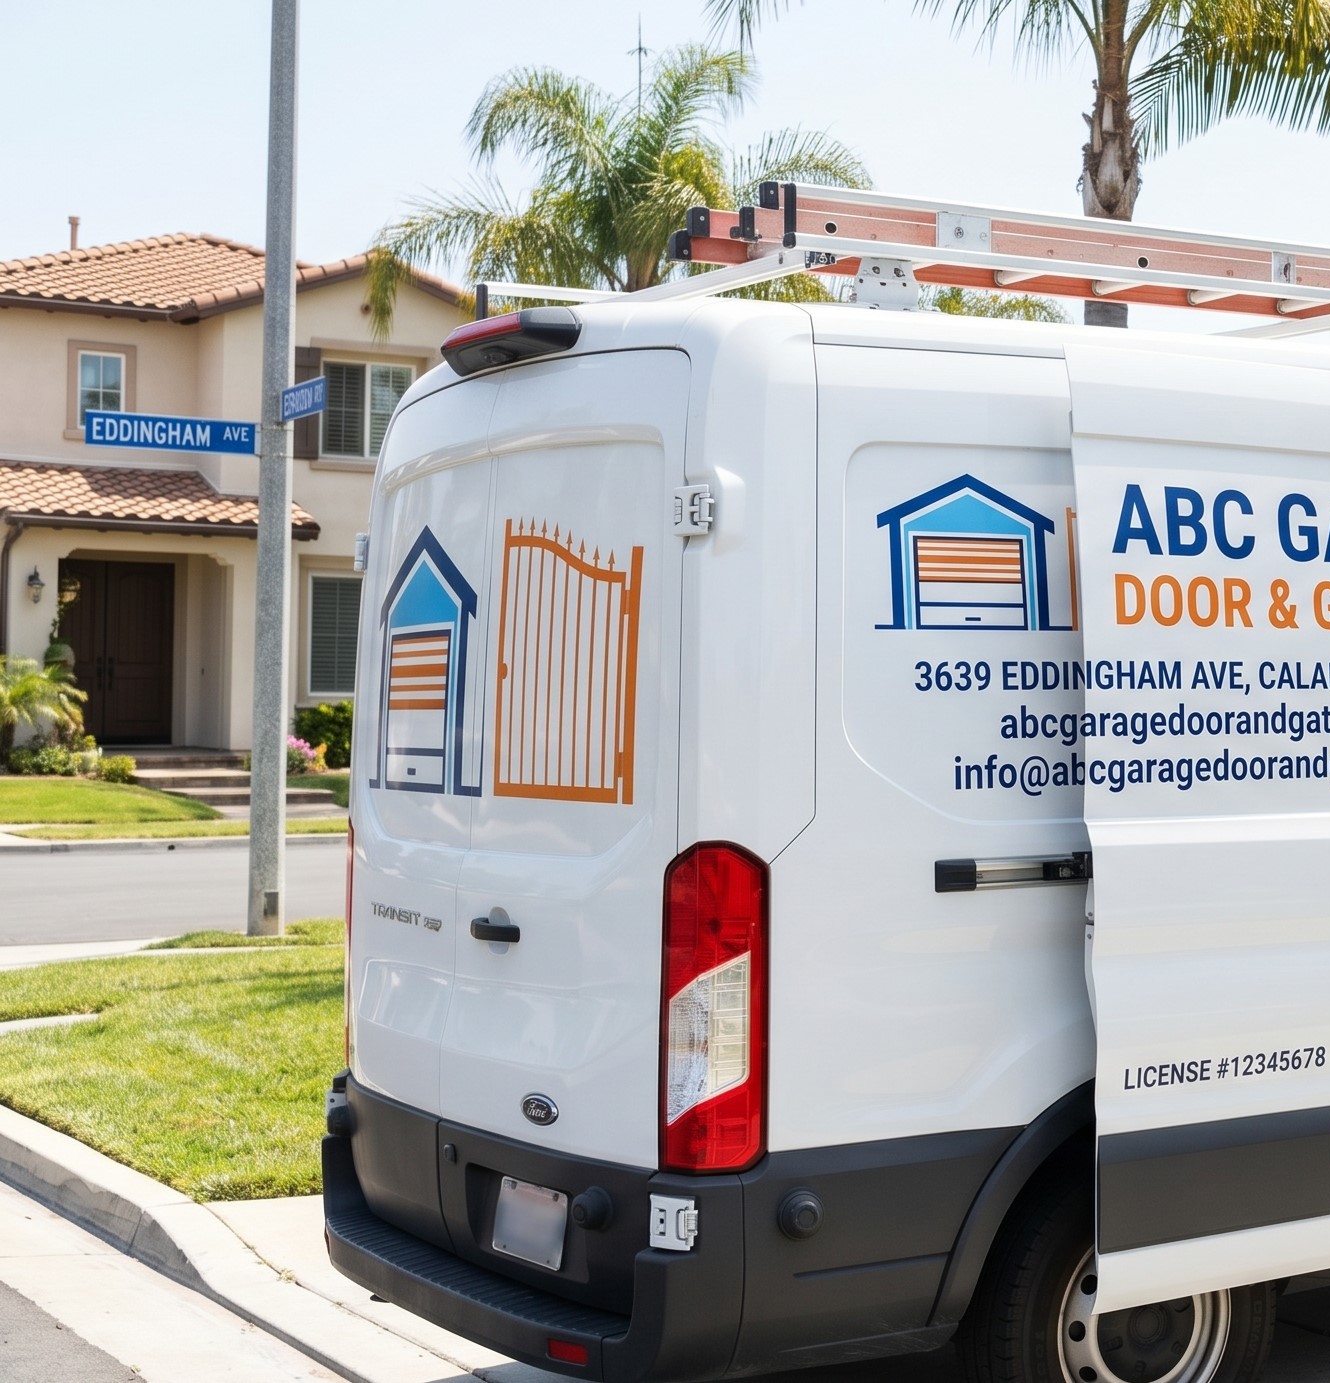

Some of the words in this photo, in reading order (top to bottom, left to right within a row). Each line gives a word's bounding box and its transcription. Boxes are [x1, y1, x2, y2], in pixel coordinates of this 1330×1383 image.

[92, 418, 211, 447] EDDINGHAM
[223, 426, 249, 442] AVE
[1112, 484, 1256, 560] ABC
[1114, 573, 1254, 628] DOOR
[1268, 578, 1299, 630] &
[914, 661, 991, 692] 3639
[1002, 661, 1182, 691] EDDINGHAM
[1191, 661, 1251, 695] AVE,
[1124, 1059, 1212, 1090] LICENSE
[1216, 1046, 1326, 1079] #12345678
